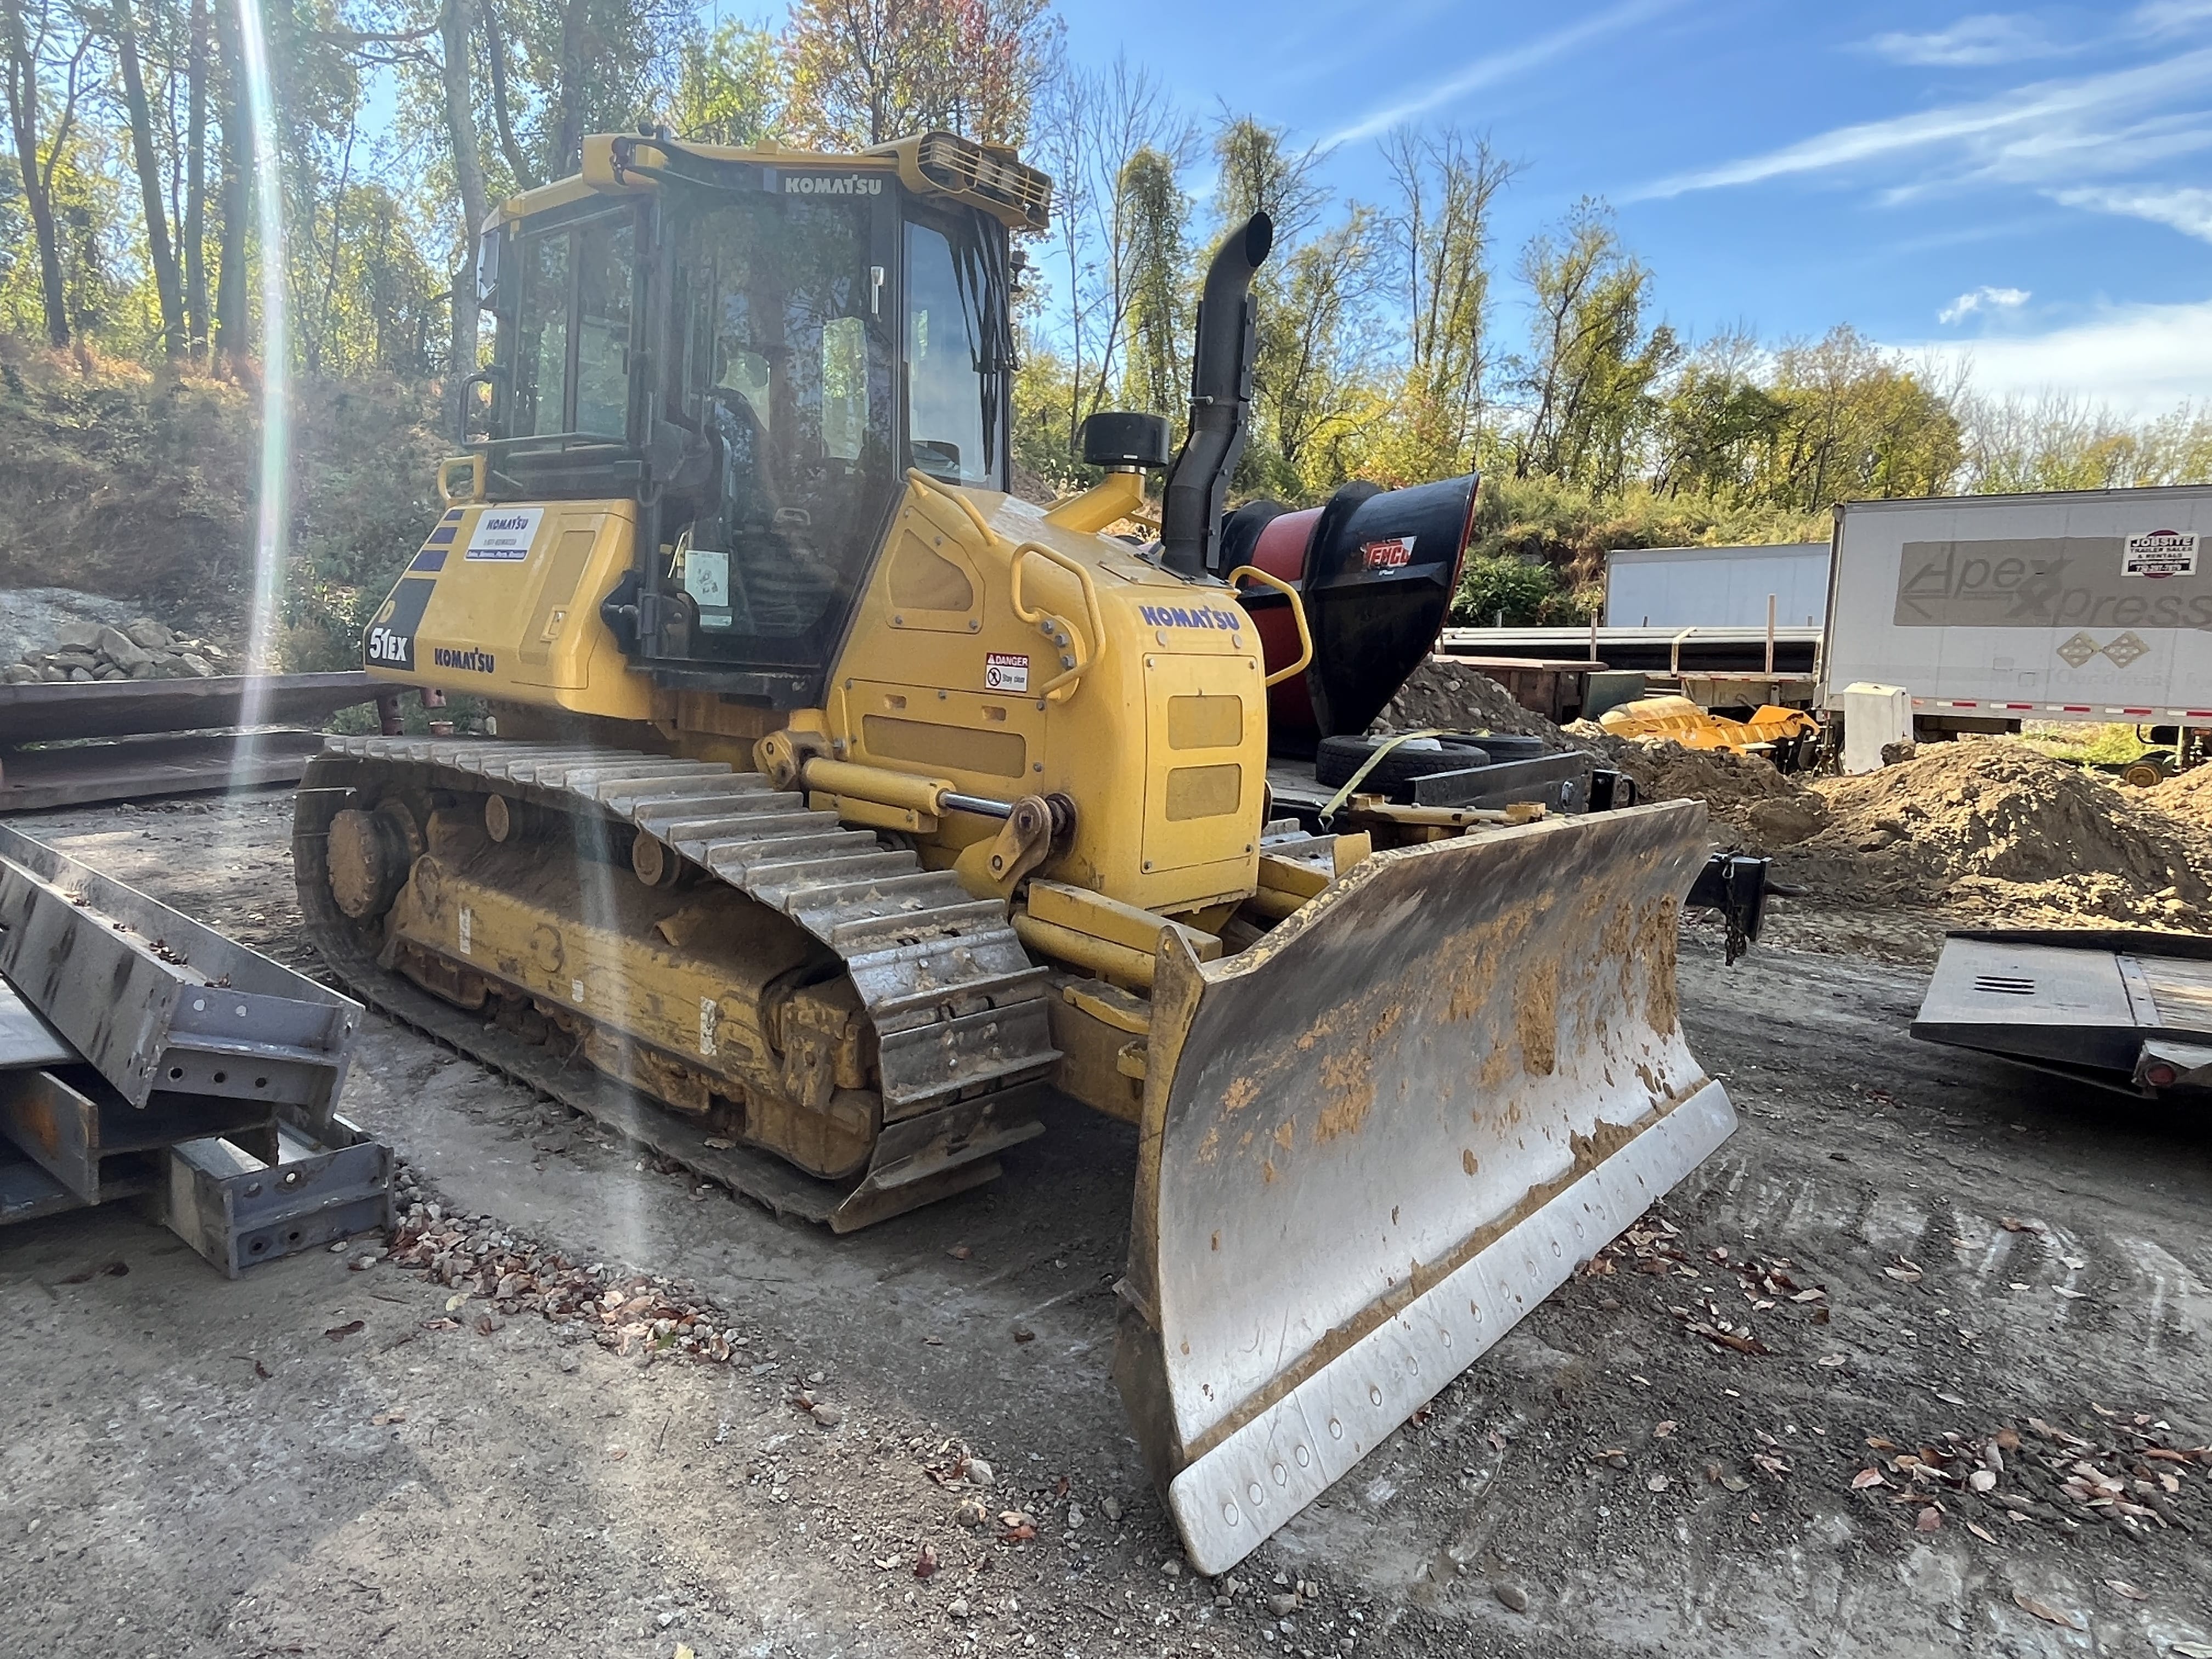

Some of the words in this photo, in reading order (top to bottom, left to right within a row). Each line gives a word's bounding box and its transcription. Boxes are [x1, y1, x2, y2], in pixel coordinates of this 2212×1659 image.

[785, 174, 882, 195] KOMATSU
[486, 516, 529, 531] KOMATSU
[1138, 605, 1240, 630] KOMATSU
[434, 647, 494, 674] KOMATSU
[995, 655, 1028, 667] DANGER
